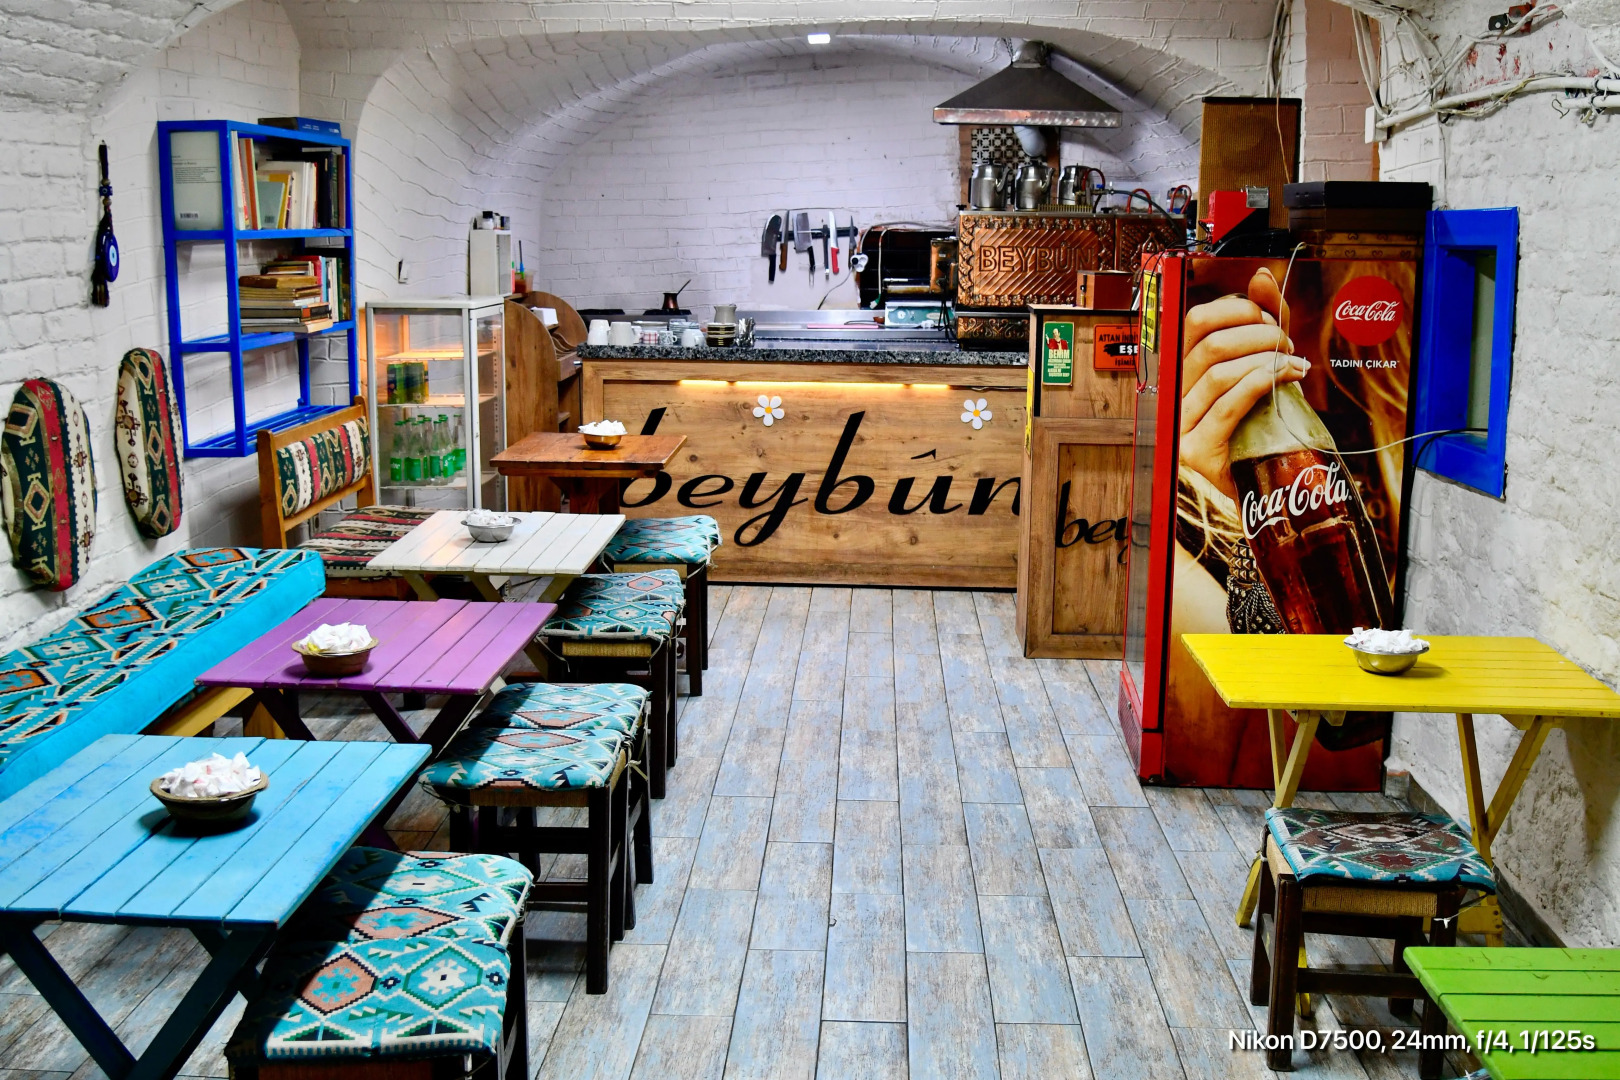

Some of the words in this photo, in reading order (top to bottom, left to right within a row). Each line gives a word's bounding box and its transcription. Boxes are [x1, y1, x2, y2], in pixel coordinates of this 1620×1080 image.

[1334, 299, 1400, 322] Coca-Cola
[1098, 334, 1121, 342] ATTAN
[1329, 359, 1363, 368] TADINI
[619, 406, 1021, 547] beybûn
[1241, 461, 1349, 540] Coca-Cola
